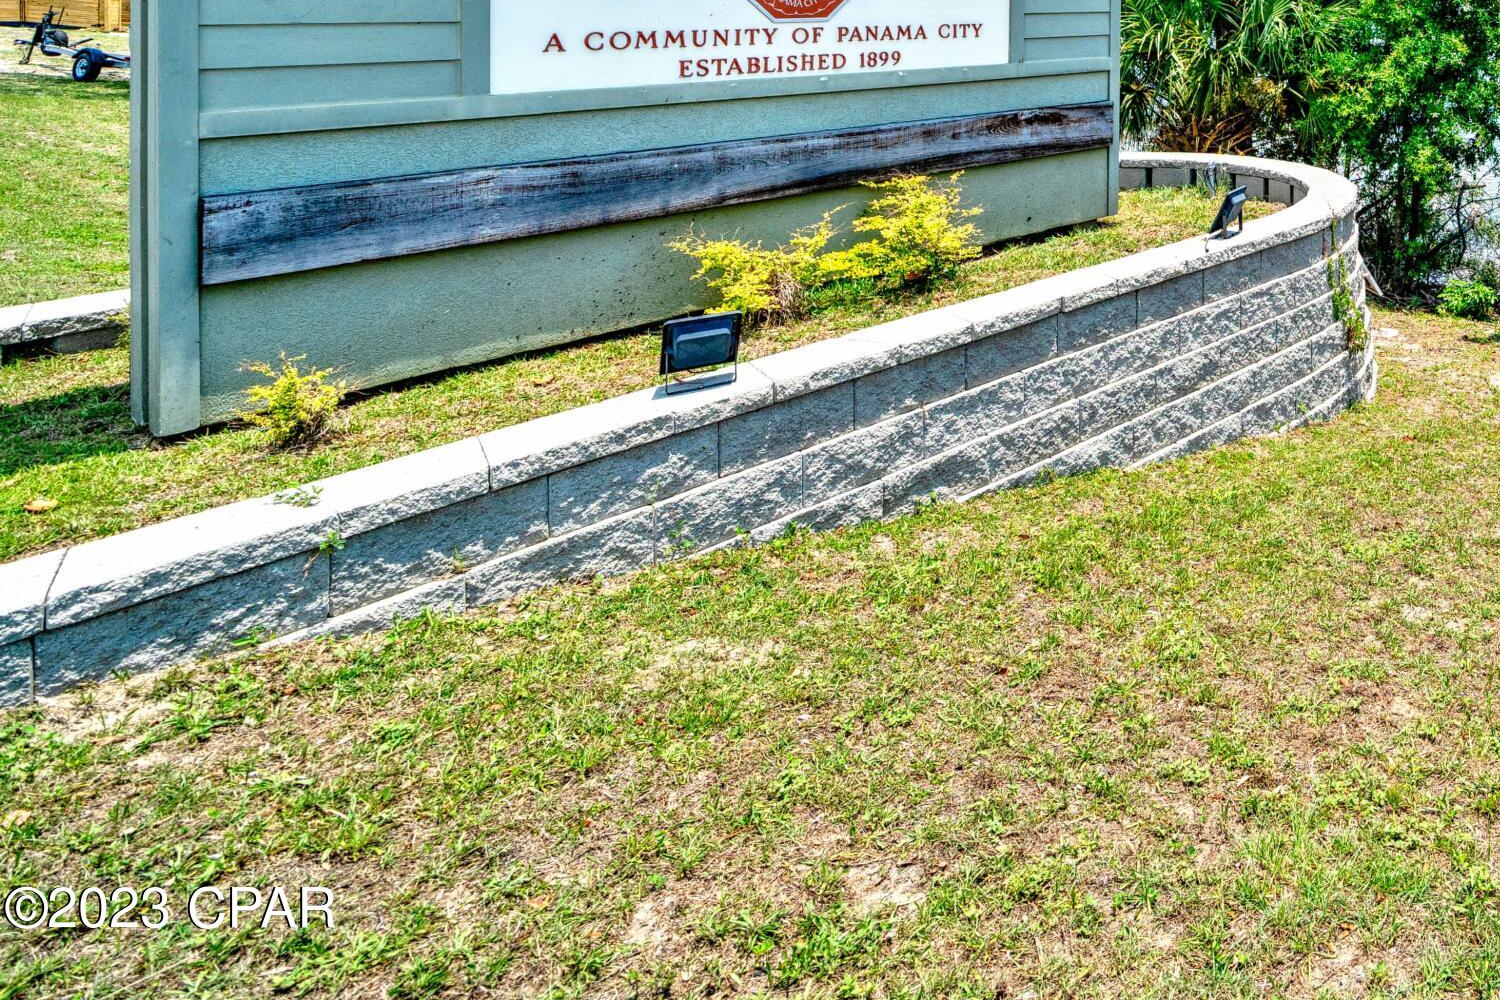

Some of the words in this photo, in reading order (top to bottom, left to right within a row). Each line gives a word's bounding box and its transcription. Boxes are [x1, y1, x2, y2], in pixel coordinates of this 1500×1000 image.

[542, 33, 566, 53] A
[584, 27, 780, 52] COMMUNITY
[791, 26, 825, 45] OF
[837, 24, 929, 43] PANAMA
[937, 23, 985, 39] CITY
[678, 53, 848, 79] ESTABLISHED
[858, 50, 903, 69] 1899
